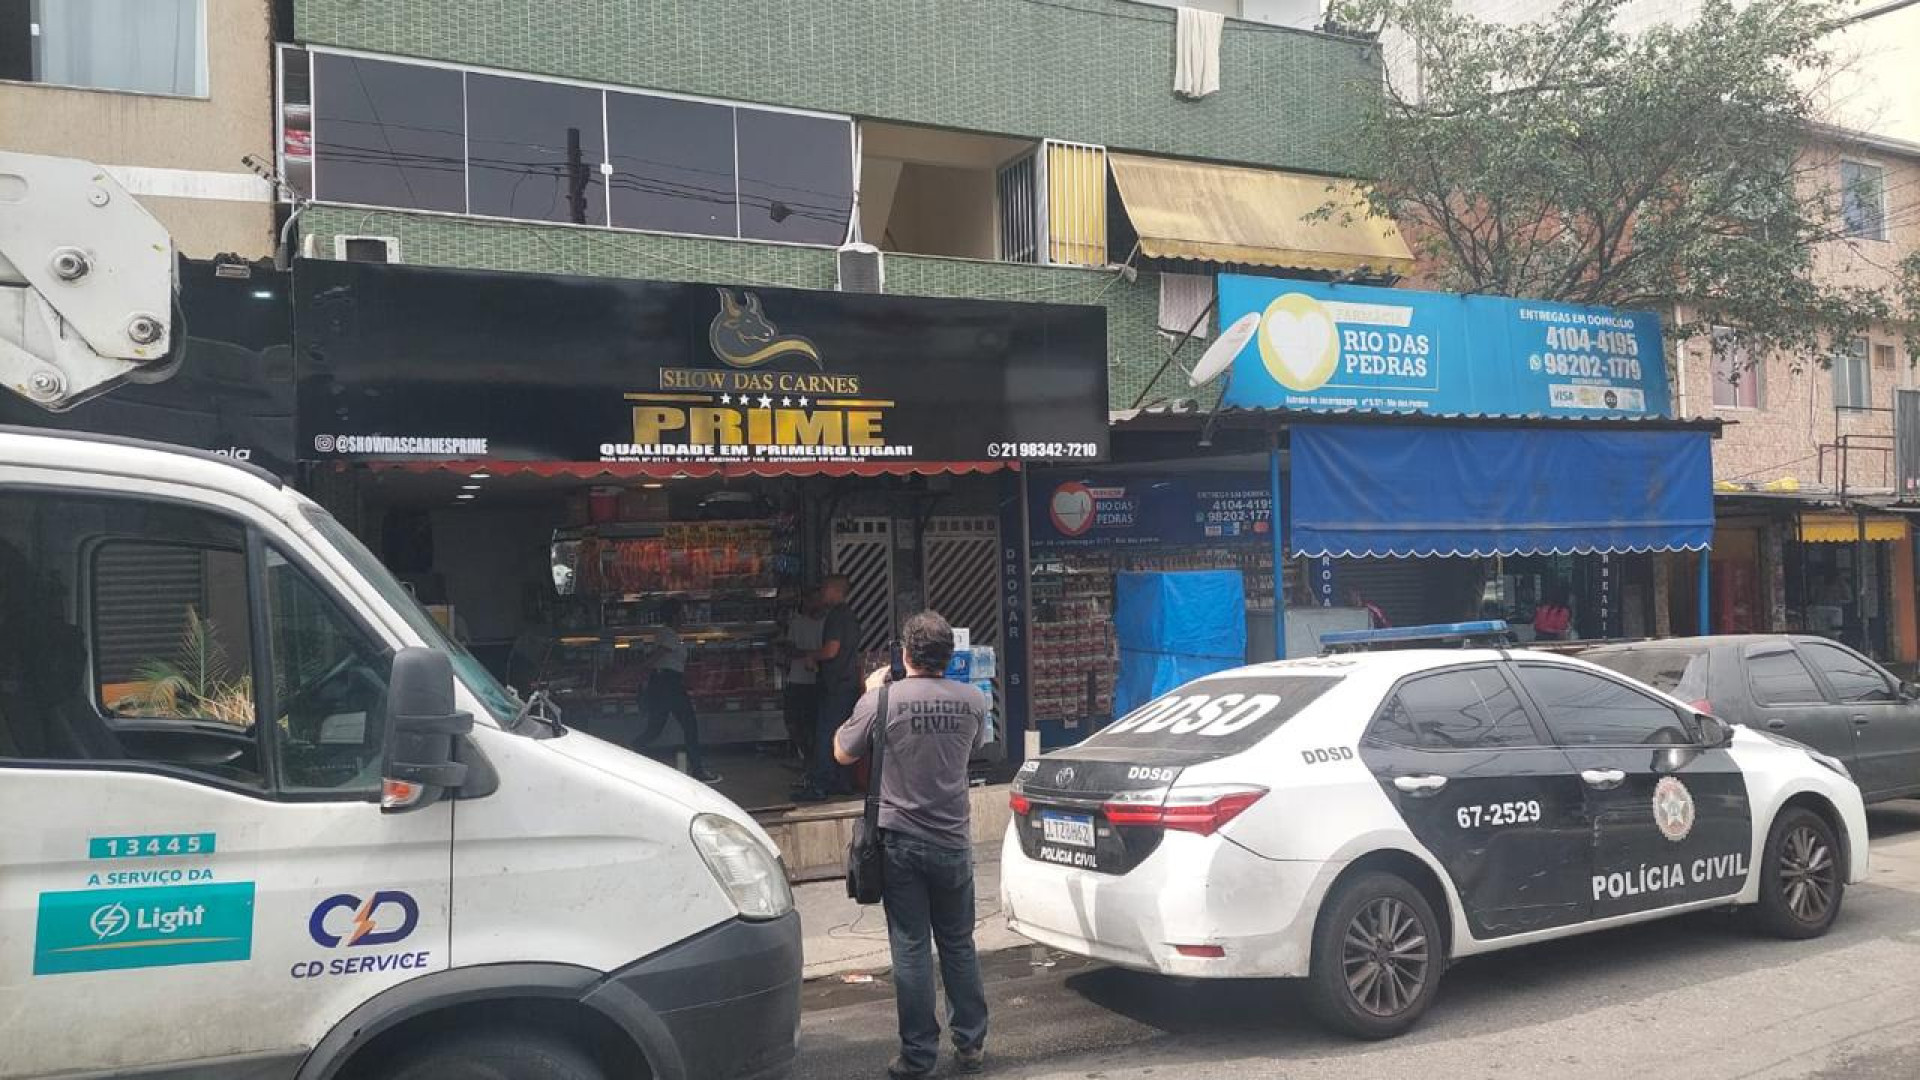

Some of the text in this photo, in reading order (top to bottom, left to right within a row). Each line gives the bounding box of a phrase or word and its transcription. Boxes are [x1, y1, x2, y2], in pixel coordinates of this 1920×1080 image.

[1519, 309, 1571, 323] ENTREGAS
[1343, 330, 1429, 355] RIO DAS
[1546, 326, 1638, 356] 4104-4195
[1345, 353, 1428, 377] PEDRAS
[1544, 352, 1642, 380] 98202-1779
[662, 370, 859, 394] SHOW DAS CARNES
[632, 405, 886, 446] PRIME
[336, 436, 488, 455] @SHOWDASCARNESPRIME
[600, 443, 913, 456] QUALIDADE EM PRIMEIRO LUGAR!
[1001, 443, 1097, 457] 21 98342-7210
[1095, 500, 1133, 511] RIO DAS
[1207, 509, 1272, 522] 98202-177
[1096, 513, 1134, 525] PEDRAS
[1322, 556, 1331, 606] ROGA
[911, 715, 960, 734] CIVIL
[1106, 694, 1282, 736] DDSD
[1301, 745, 1354, 765] DDSD
[1128, 766, 1173, 781] DDSD
[1457, 800, 1541, 829] 67-2529
[107, 838, 201, 856] 13445
[1074, 852, 1098, 868] CIVIL
[88, 867, 214, 887] A SERVIÇO DA
[1592, 852, 1750, 901] POLÍCIA CIVIL
[138, 904, 206, 936] Light
[309, 890, 420, 948] CD
[290, 951, 431, 979] CD SERVICE
